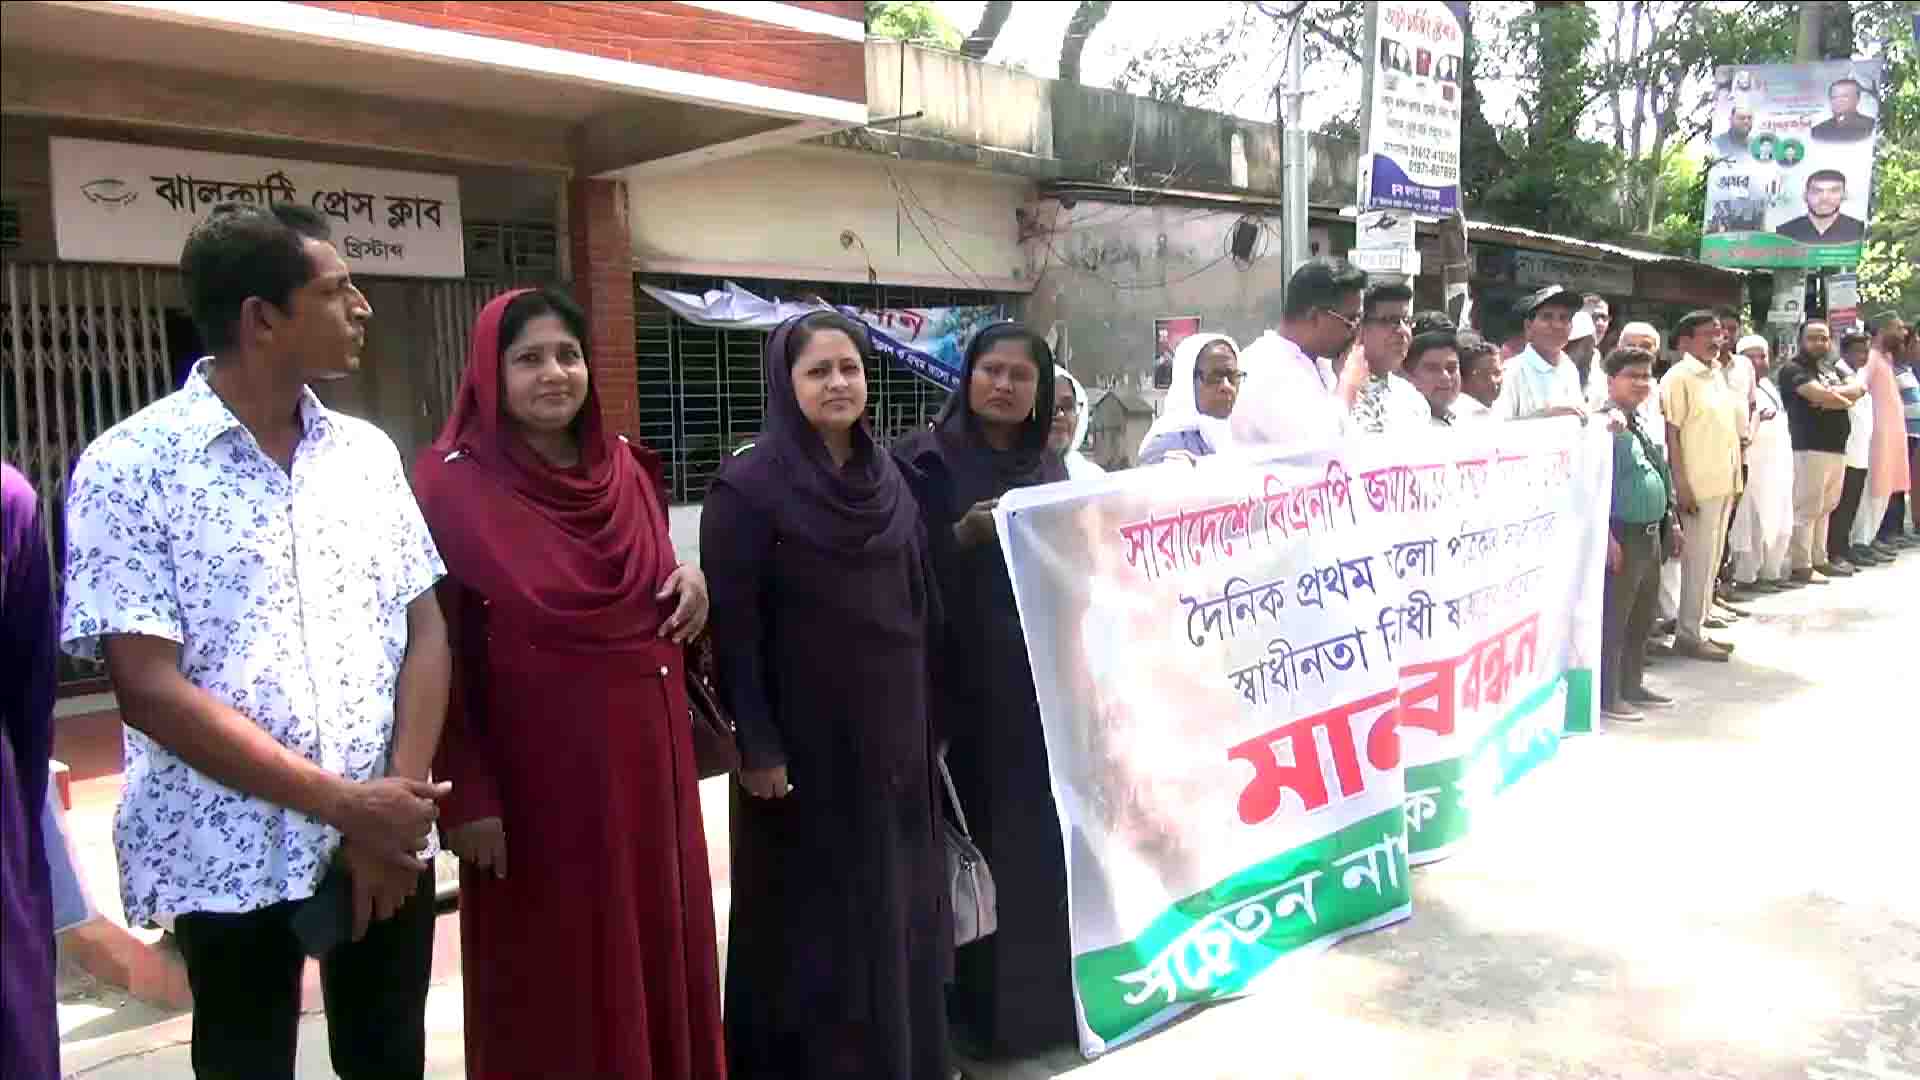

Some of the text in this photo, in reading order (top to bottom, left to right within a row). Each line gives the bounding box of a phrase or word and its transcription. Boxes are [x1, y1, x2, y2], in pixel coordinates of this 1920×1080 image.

[311, 187, 376, 224] প্রেস
[384, 194, 444, 230] ক্লাব
[1119, 494, 1256, 582] সারাদেশে
[1264, 459, 1356, 543] বিএনপি
[1180, 577, 1285, 647] দৈনিক
[1296, 556, 1376, 610] প্রথম
[1384, 535, 1438, 579] লো
[1228, 626, 1368, 705] স্বাধীনতা
[1114, 869, 1324, 1006] সচেতন
